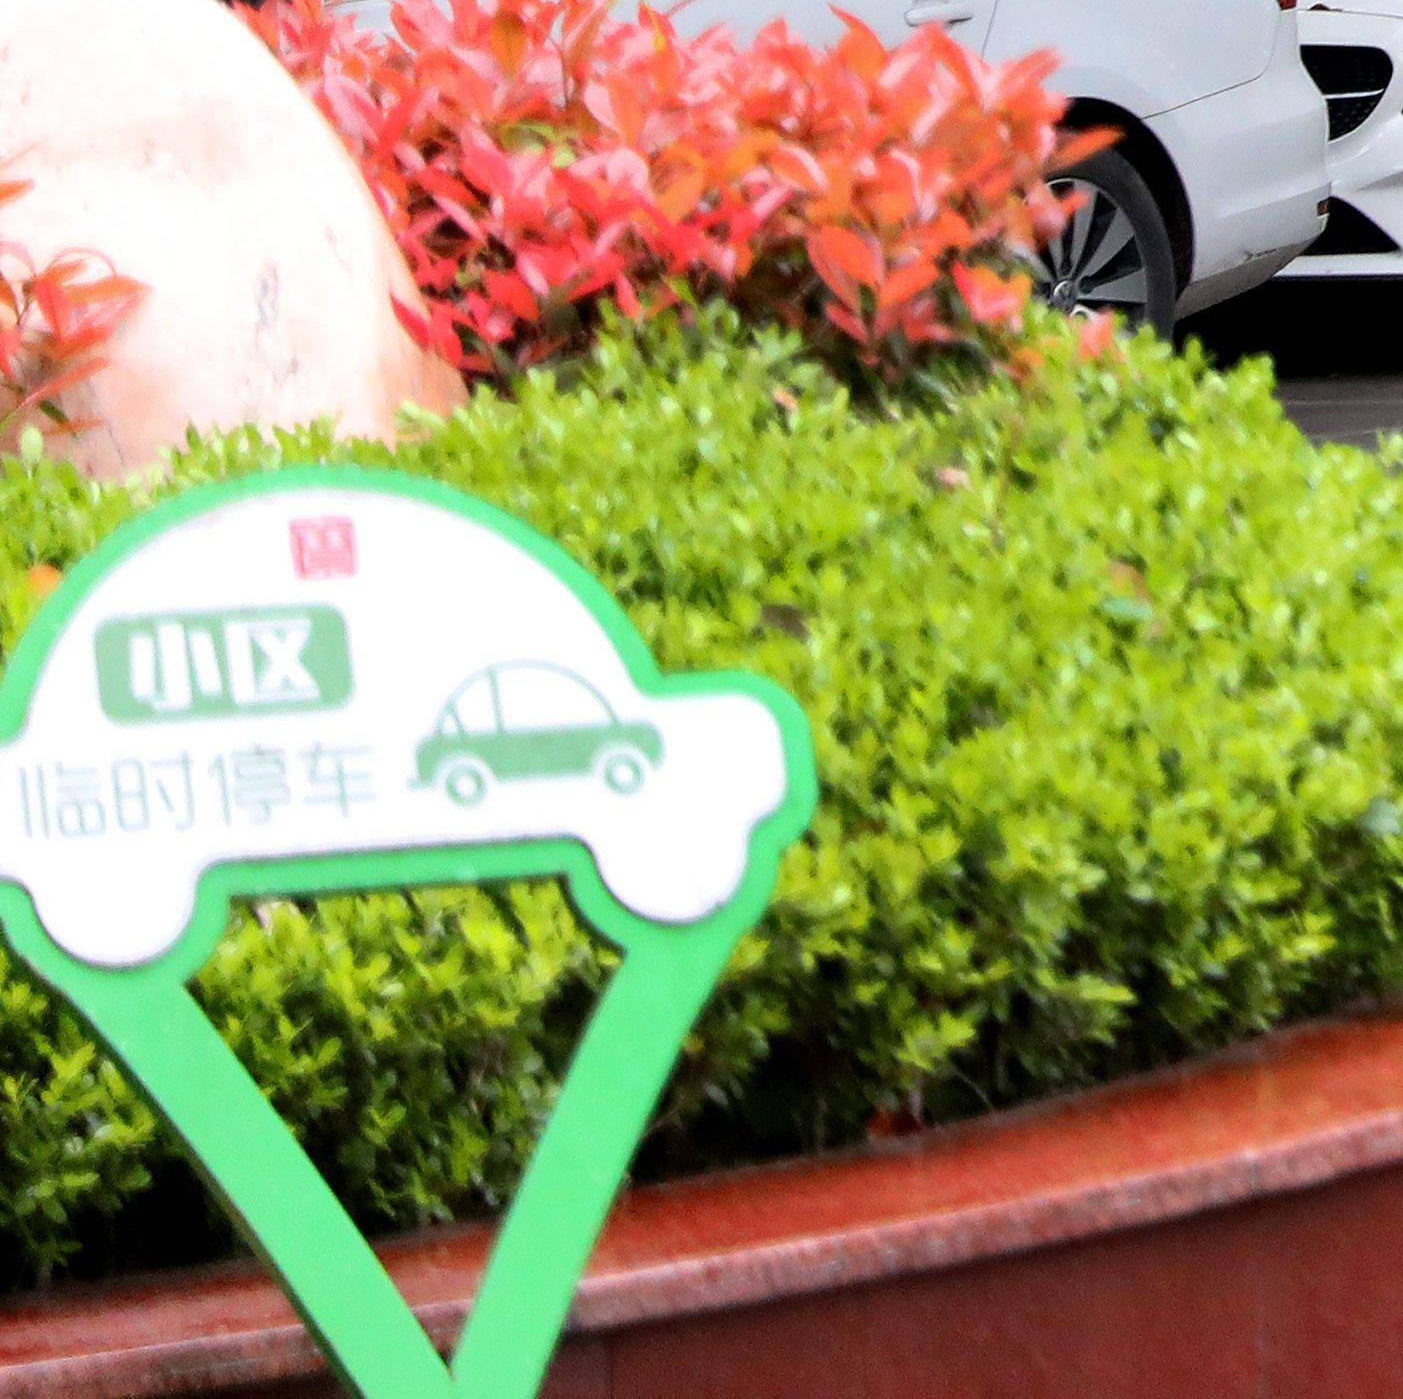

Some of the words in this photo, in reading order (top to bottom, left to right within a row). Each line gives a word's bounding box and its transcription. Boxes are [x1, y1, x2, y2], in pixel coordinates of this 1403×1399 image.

[129, 618, 321, 711] 小区
[18, 740, 378, 840] 临时停车
